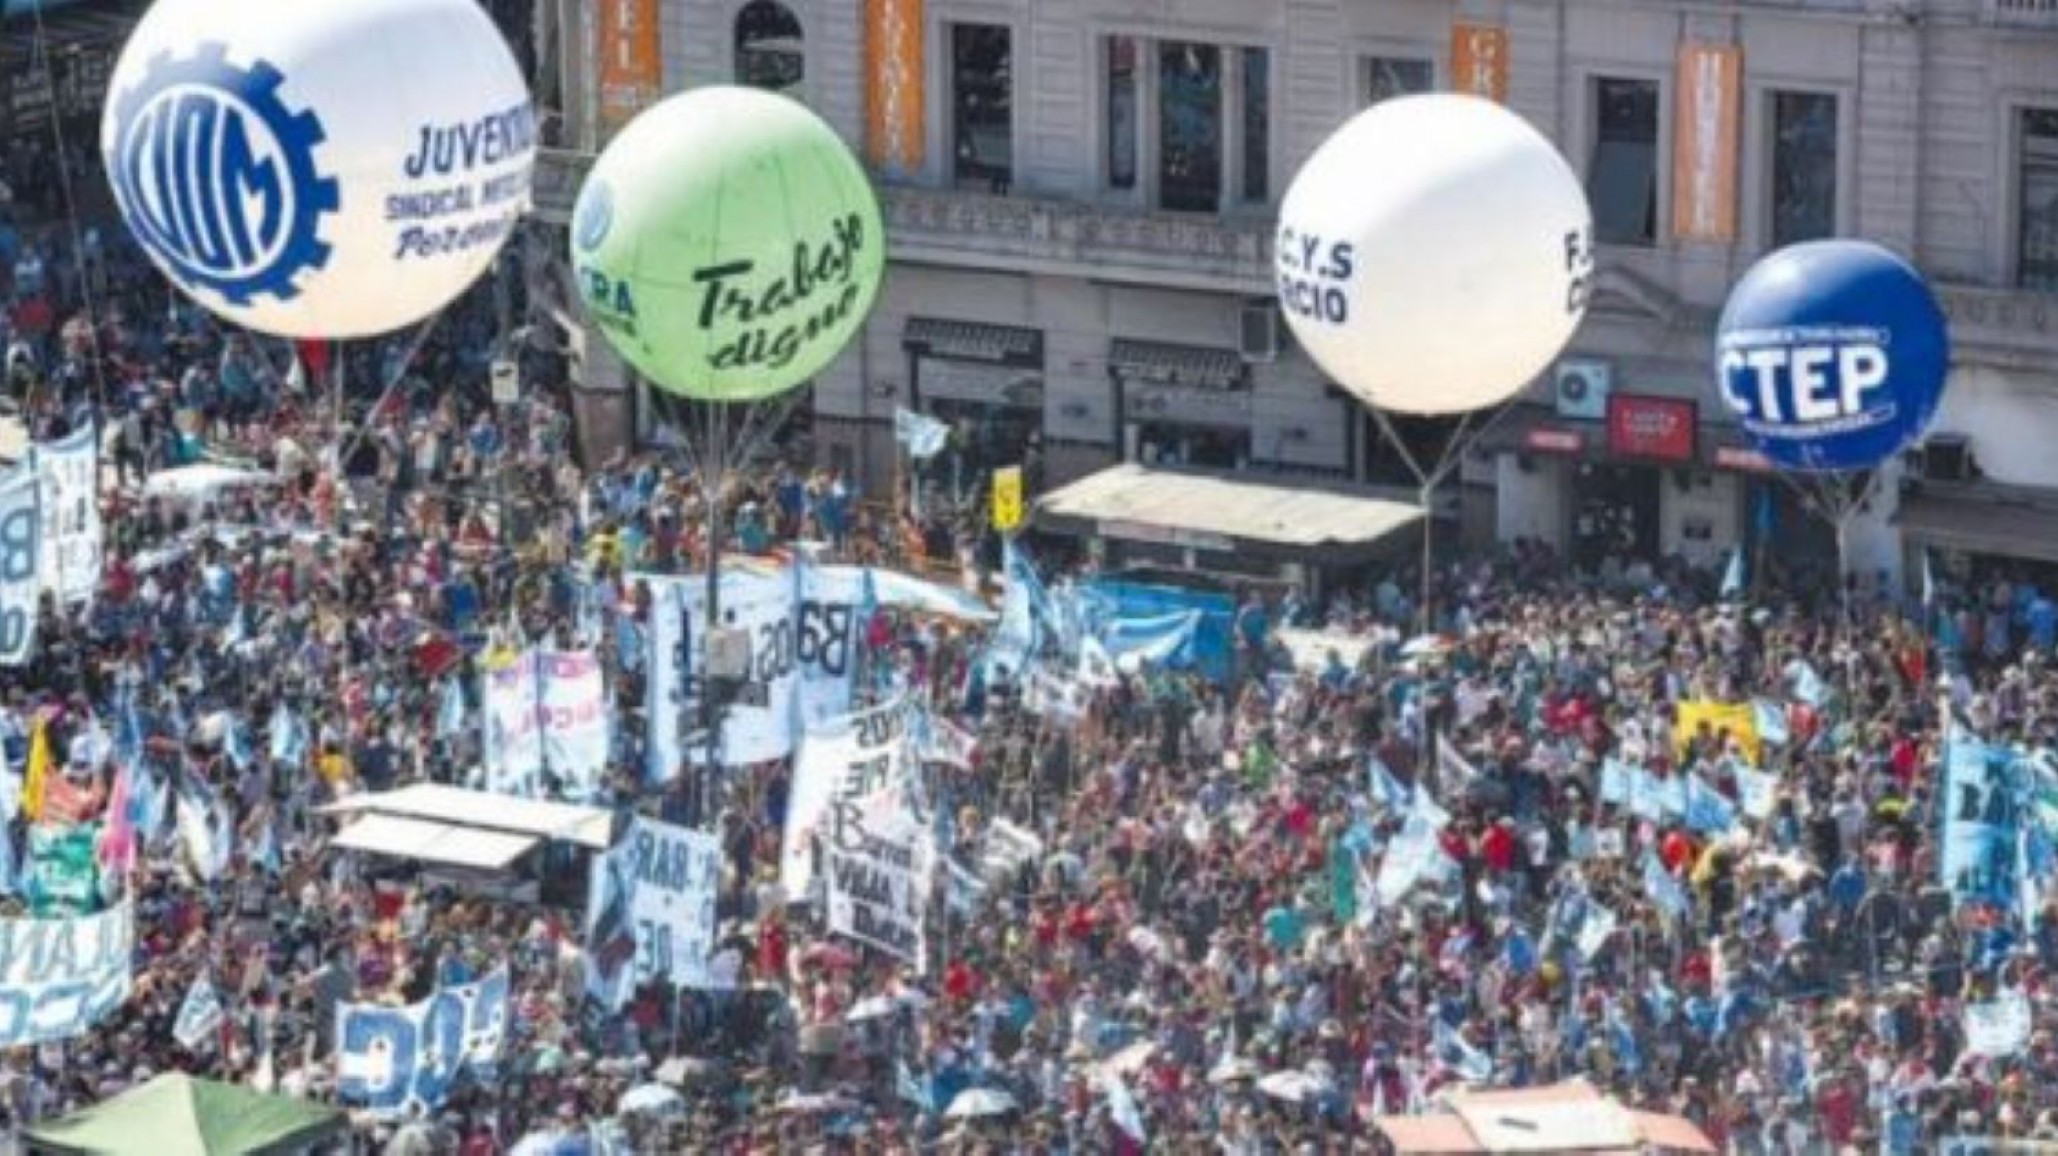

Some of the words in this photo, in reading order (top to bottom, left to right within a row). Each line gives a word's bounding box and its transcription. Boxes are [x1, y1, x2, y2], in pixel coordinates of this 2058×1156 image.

[692, 211, 864, 330] Trabajo
[706, 283, 859, 370] digno
[1721, 343, 1889, 422] CTEP
